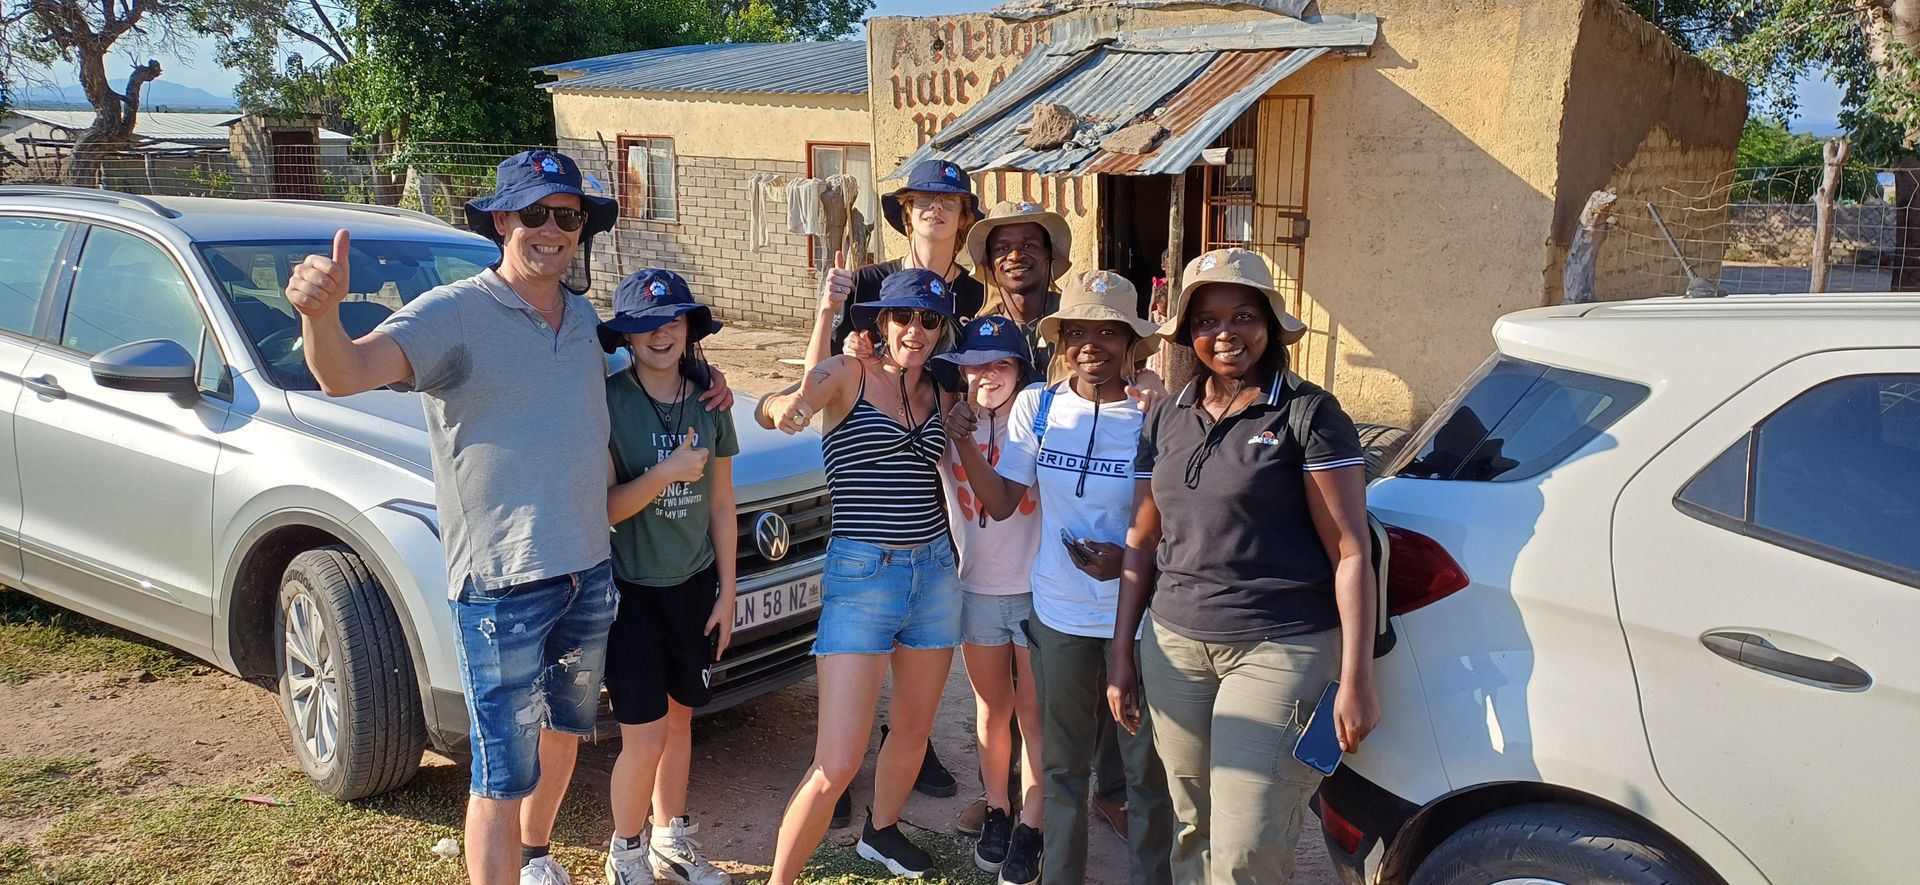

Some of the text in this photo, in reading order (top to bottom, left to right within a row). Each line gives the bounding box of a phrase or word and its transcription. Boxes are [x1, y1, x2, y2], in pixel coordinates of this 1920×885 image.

[1038, 452, 1125, 474] GRIDLINE
[655, 508, 664, 516] OF
[664, 510, 676, 519] MY
[734, 582, 807, 627] LN 58 NZ
